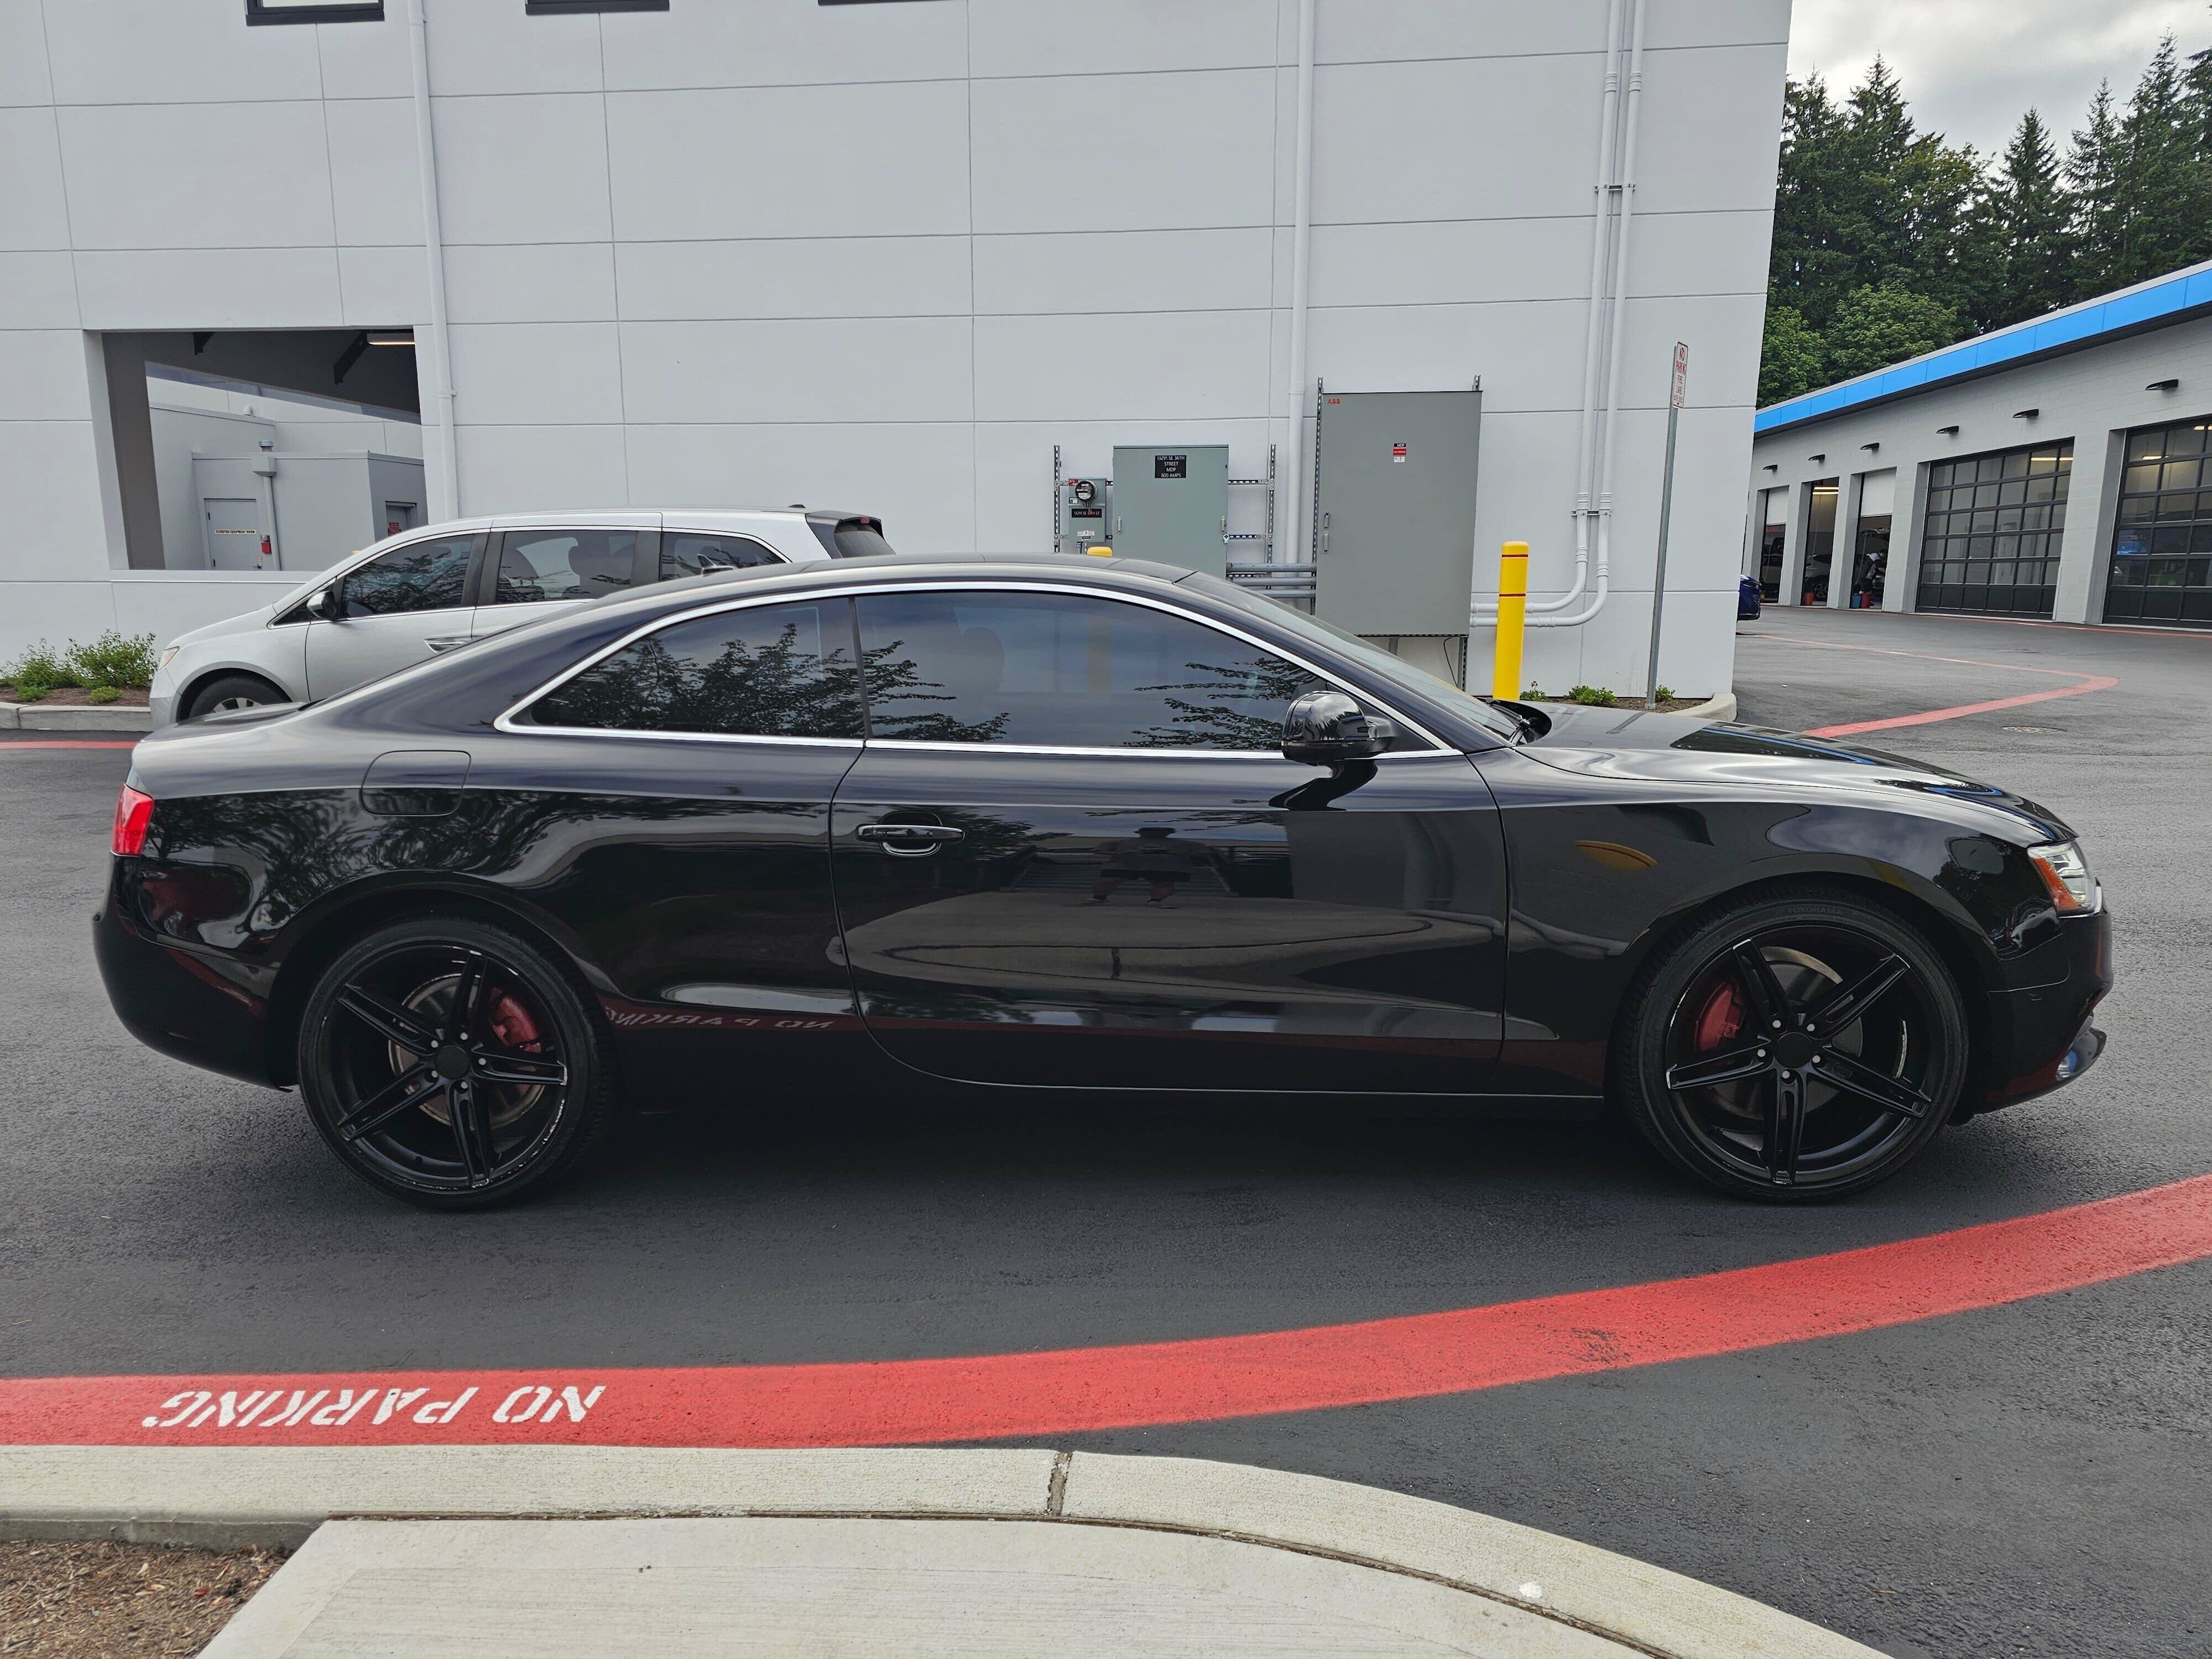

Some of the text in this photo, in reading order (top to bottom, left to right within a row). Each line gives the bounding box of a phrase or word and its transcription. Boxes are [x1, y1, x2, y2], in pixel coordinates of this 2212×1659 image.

[1788, 906, 1841, 915] YOKOHAMA
[141, 1385, 607, 1428] NO PARKING
